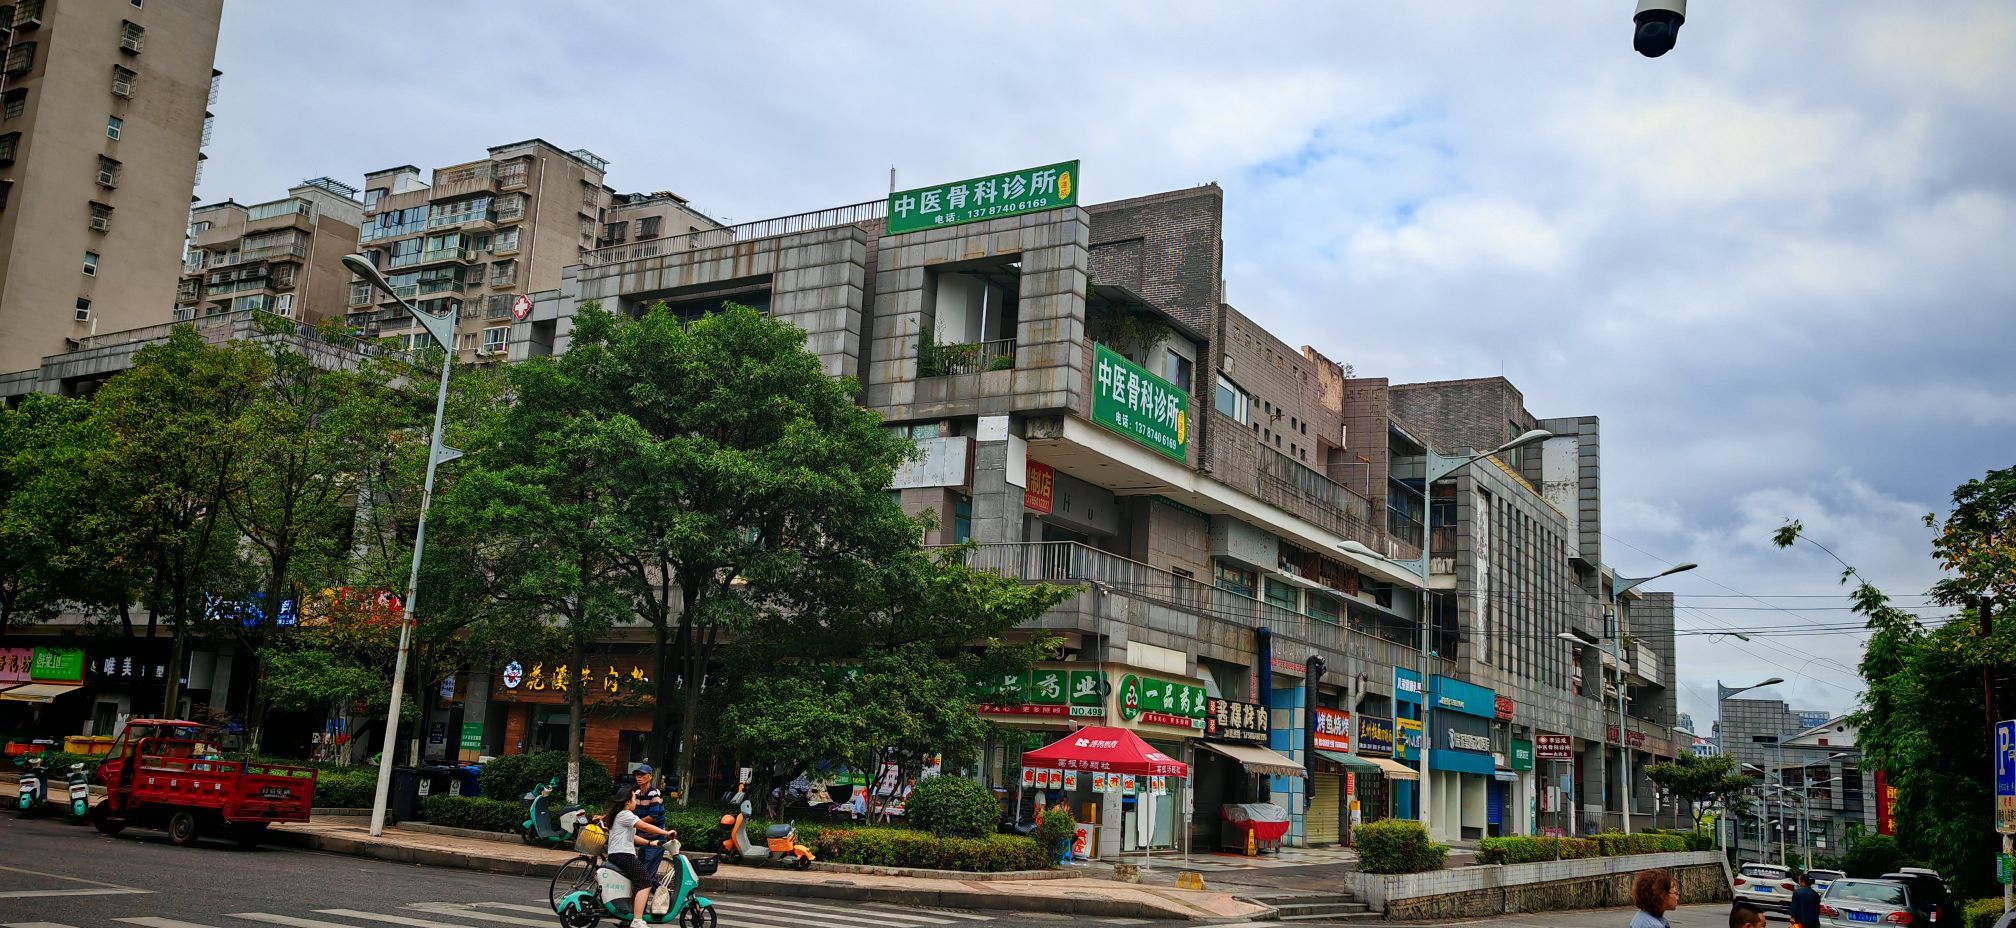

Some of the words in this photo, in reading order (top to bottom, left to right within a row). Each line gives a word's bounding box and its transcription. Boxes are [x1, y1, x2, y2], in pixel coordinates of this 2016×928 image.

[894, 168, 1056, 219] 中医骨科诊所
[967, 209, 986, 219] 137
[988, 203, 1016, 215] 8740
[1018, 197, 1047, 210] 6169
[1098, 357, 1179, 432] 中医骨科诊所
[1134, 421, 1146, 435] 137
[1146, 427, 1162, 443] 8740
[1162, 434, 1177, 450] 6169
[103, 656, 166, 678] 唯美型
[1145, 683, 1206, 713] 一品药业
[1317, 711, 1349, 737] 烤鱼烧烤
